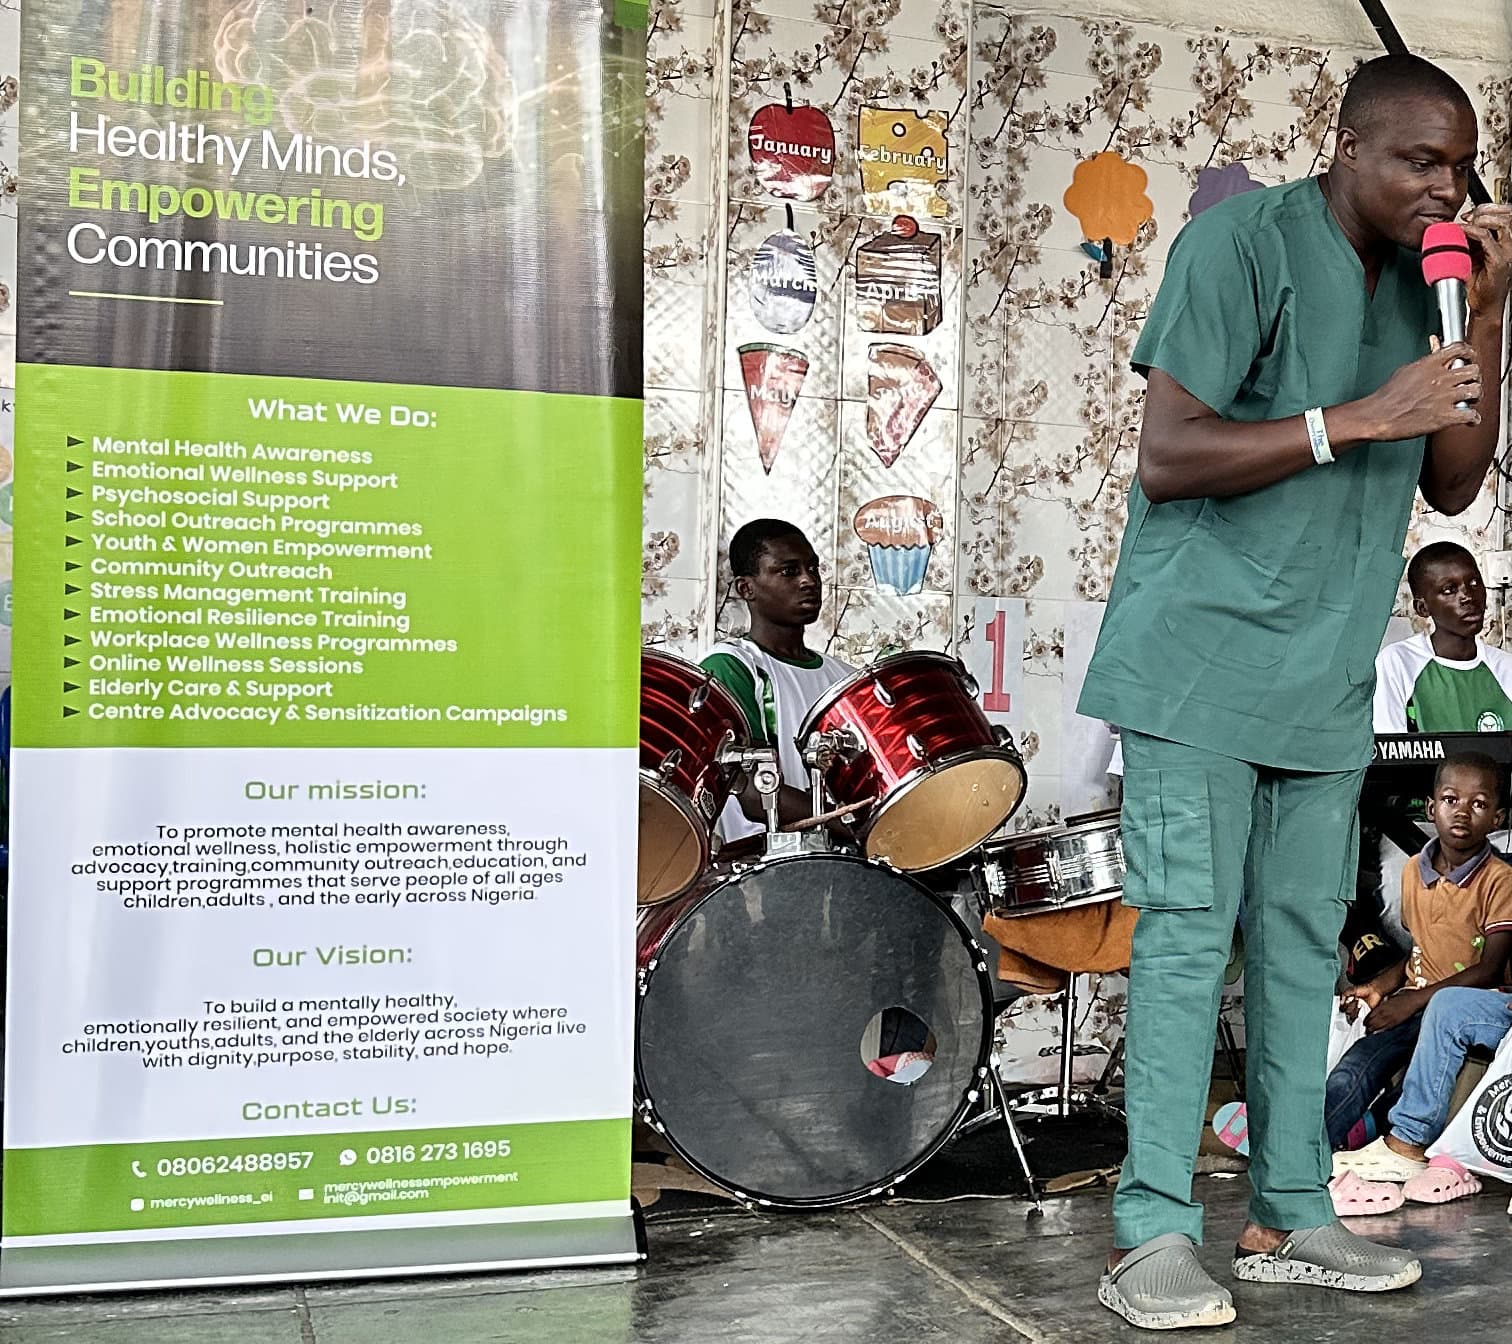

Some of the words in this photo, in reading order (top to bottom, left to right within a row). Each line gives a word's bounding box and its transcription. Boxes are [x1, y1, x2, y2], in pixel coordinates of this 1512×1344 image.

[70, 55, 274, 126] Building
[69, 111, 251, 176] Healthy
[262, 131, 406, 185] Minds,
[749, 134, 832, 164] January
[858, 144, 947, 173] February
[69, 167, 384, 241] Empowering
[67, 223, 378, 283] Communities
[751, 268, 817, 292] March
[750, 385, 797, 407] May
[247, 398, 328, 421] What
[335, 403, 382, 424] We
[389, 405, 437, 427] Do:
[92, 436, 170, 455] Mental
[174, 440, 248, 458] Health
[251, 444, 373, 464] Awareness
[91, 460, 205, 480] Emotional
[209, 465, 308, 484] Wellness
[311, 469, 399, 491] Support
[91, 485, 238, 506] Psychosocial
[241, 490, 330, 512] Support
[91, 509, 167, 527] School
[171, 512, 277, 530] Outreach
[280, 515, 423, 537] Programmes
[91, 533, 157, 550] Youth
[161, 535, 177, 551] &
[181, 536, 268, 554] Women
[272, 539, 433, 559] Empowerment
[90, 558, 225, 581] Community
[228, 561, 333, 579] Outreach
[90, 581, 159, 599] Stress
[163, 584, 314, 605] Management
[317, 586, 407, 609] Training
[89, 606, 203, 624] Emotional
[207, 608, 318, 626] Resilience
[321, 610, 411, 633] Training
[89, 630, 210, 651] Workplace
[214, 632, 313, 649] Wellness
[317, 634, 458, 655] Programmes
[88, 654, 162, 671] Online
[165, 655, 265, 672] Wellness
[268, 656, 364, 673] Sessions
[983, 609, 1010, 712] 1
[88, 678, 164, 699] Elderly
[167, 679, 222, 696] Care
[225, 679, 241, 696] &
[245, 680, 333, 701] Support
[87, 702, 165, 719] Centre
[168, 703, 282, 724] Advocacy
[284, 703, 301, 720] &
[304, 703, 442, 720] Sensitization
[445, 705, 568, 725] Campaigns
[1378, 740, 1446, 760] YAMAHA
[244, 780, 300, 799] Our
[308, 780, 427, 799] mission:
[155, 825, 179, 839] To
[183, 824, 267, 843] promote
[271, 823, 338, 838] mental
[343, 822, 403, 836] health
[406, 824, 511, 840] awareness,
[91, 842, 191, 856] emotional
[195, 841, 280, 857] wellness,
[285, 840, 352, 854] holistic
[355, 839, 493, 856] empowerment
[496, 837, 568, 854] through
[551, 853, 587, 866] and
[96, 876, 172, 895] support
[176, 874, 303, 894] programmes
[306, 874, 346, 887] that
[350, 875, 400, 887] serve
[405, 872, 469, 889] people
[472, 870, 491, 884] of
[494, 870, 515, 884] all
[519, 872, 564, 887] ages
[277, 891, 315, 905] and
[319, 890, 350, 904] the
[354, 889, 402, 907] early
[405, 891, 467, 902] across
[252, 948, 308, 967] Our
[315, 944, 413, 964] Vision:
[202, 1000, 226, 1014] To
[230, 998, 277, 1013] build
[281, 1000, 294, 1011] a
[298, 995, 380, 1012] mentally
[385, 993, 457, 1010] healthy,
[83, 1018, 199, 1035] emotionally
[203, 1016, 281, 1031] resilient,
[285, 1013, 323, 1028] and
[326, 1010, 439, 1029] empowered
[443, 1008, 509, 1025] society
[512, 1006, 567, 1021] where
[281, 1030, 319, 1045] and
[323, 1030, 354, 1043] the
[357, 1027, 421, 1044] elderly
[424, 1027, 485, 1039] across
[489, 1021, 553, 1040] Nigeria
[556, 1021, 587, 1033] live
[142, 1053, 183, 1068] with
[343, 1043, 419, 1061] stability,
[422, 1042, 459, 1056] and
[463, 1042, 513, 1059] hope.
[241, 1099, 363, 1120] Contact
[372, 1096, 417, 1114] Us:
[156, 1151, 314, 1175] 08062488957
[366, 1144, 416, 1164] 0816
[420, 1142, 459, 1161] 273
[462, 1139, 511, 1158] 1695
